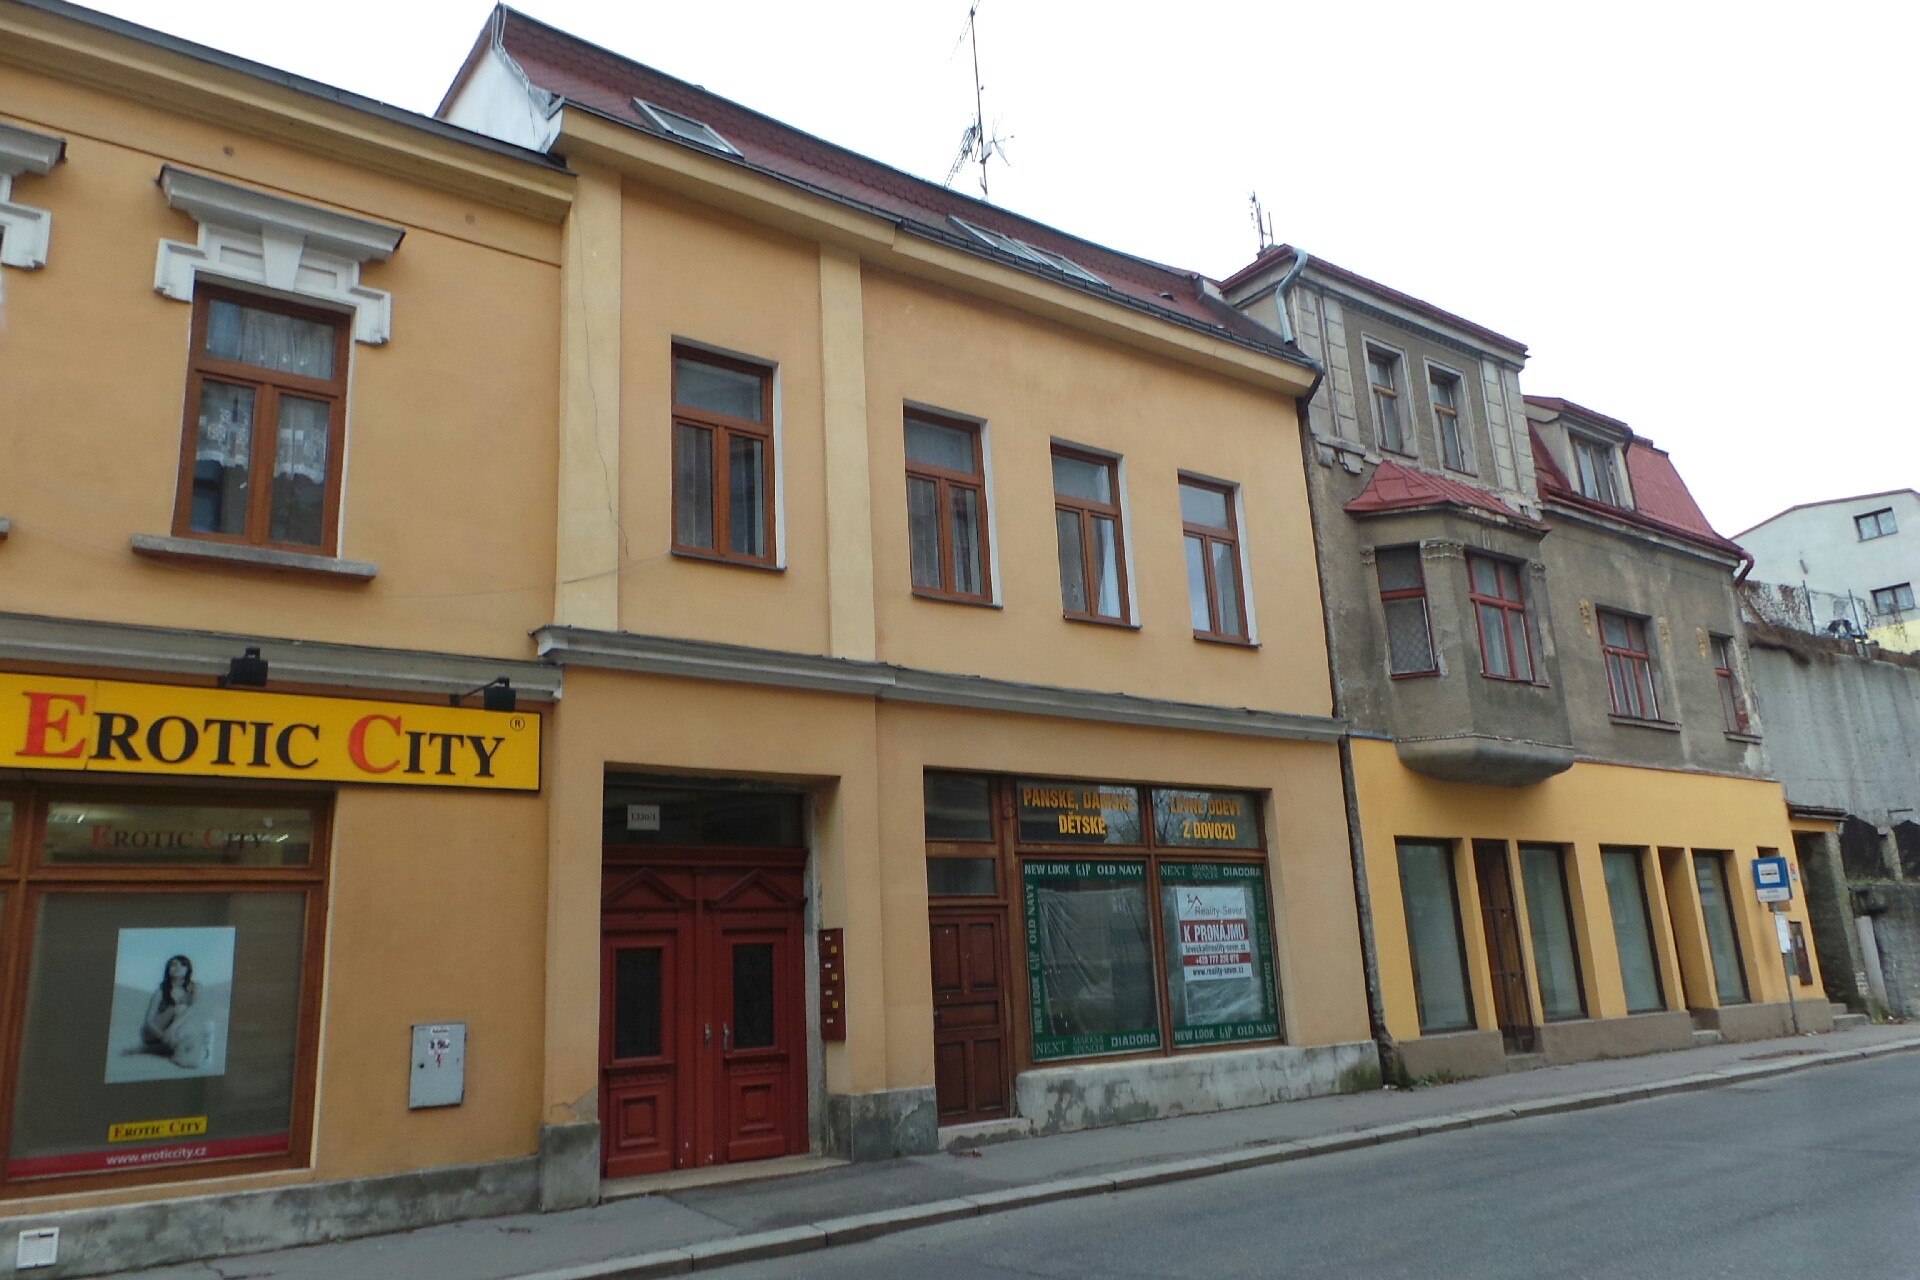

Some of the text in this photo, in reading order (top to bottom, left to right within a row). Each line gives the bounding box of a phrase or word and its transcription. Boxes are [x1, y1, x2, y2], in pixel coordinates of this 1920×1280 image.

[15, 691, 320, 769] EROTIC
[347, 714, 505, 778] CITY
[91, 824, 193, 849] EROTIC
[1183, 821, 1236, 840] Z DOVOZU
[1024, 864, 1045, 875] NEW
[1047, 864, 1070, 875] LOOK
[1096, 864, 1116, 875] OLD
[1119, 864, 1143, 875] NAVY
[1160, 865, 1186, 876] NEXT
[1222, 866, 1261, 877] DIADORA
[1025, 883, 1035, 916] NAVY
[1194, 906, 1243, 917] Reality-Sever
[1028, 919, 1037, 944] OLD
[1183, 920, 1245, 942] K PRONÁJMU
[1032, 976, 1041, 1004] LOOK
[1034, 1006, 1043, 1033] NEW
[1111, 1033, 1157, 1047] DIADORA
[1174, 1031, 1193, 1041] NEW
[1194, 1029, 1215, 1039] LOOK
[1237, 1025, 1254, 1036] OLD
[1256, 1023, 1277, 1035] NAVY
[1036, 1042, 1066, 1055] NEXT
[106, 1147, 207, 1165] www.eroticcity.cz
